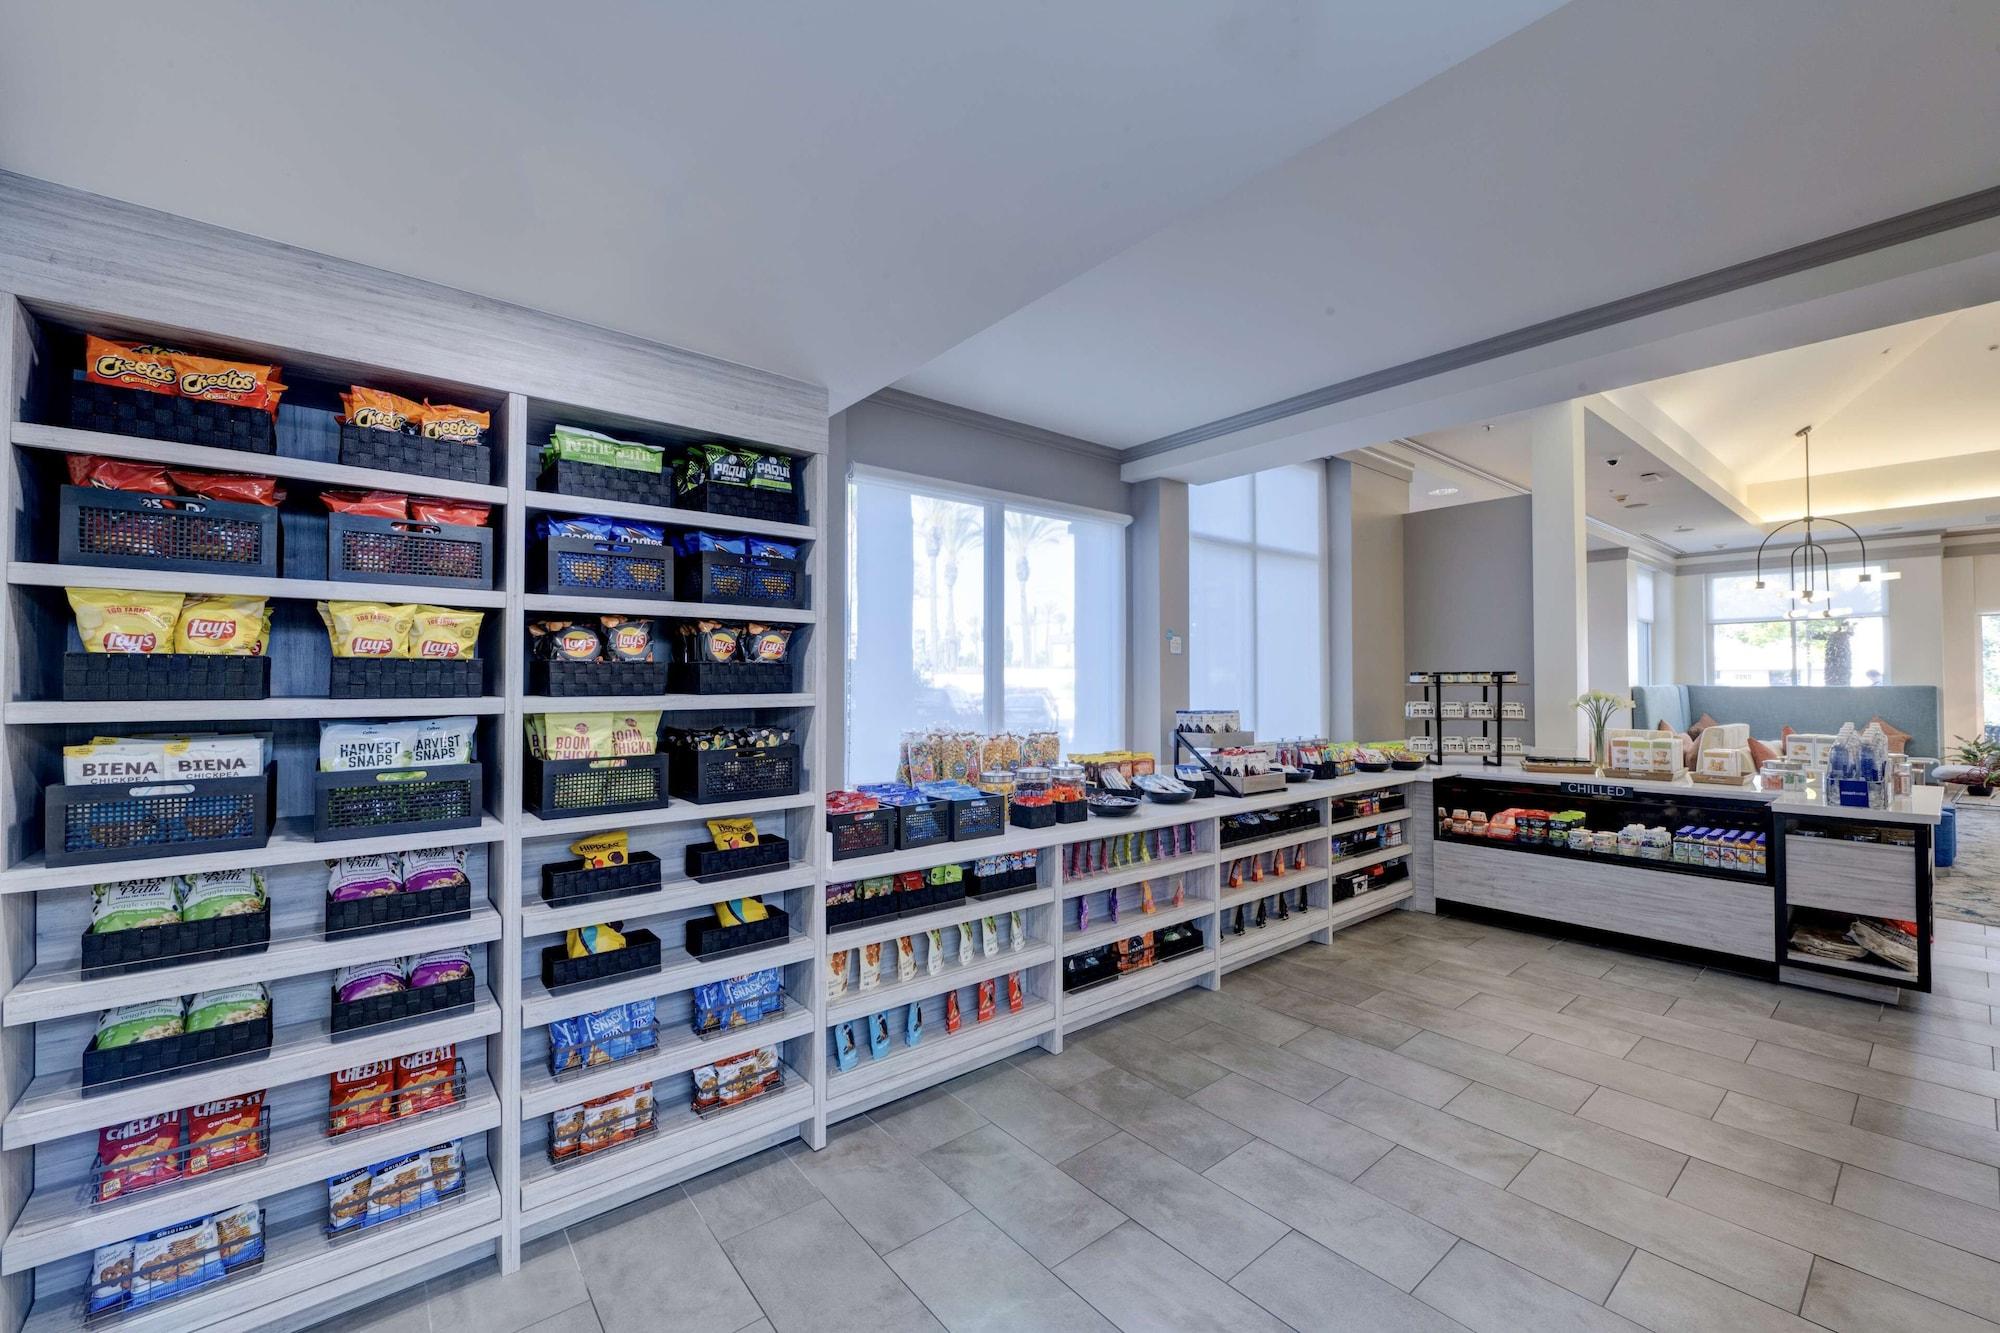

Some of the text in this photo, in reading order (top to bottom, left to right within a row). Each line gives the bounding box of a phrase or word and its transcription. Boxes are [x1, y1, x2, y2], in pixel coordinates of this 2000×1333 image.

[96, 356, 176, 383] Cheetos
[180, 369, 256, 394] Cheetos
[424, 420, 481, 439] Cheetos
[713, 462, 747, 479] PAQUI
[756, 462, 790, 479] PAQUI
[190, 619, 234, 640] Lay's
[107, 632, 154, 653] Lay's
[354, 637, 392, 654] Lay's
[424, 640, 458, 658] Lay's
[564, 637, 595, 652] Lay's
[619, 634, 645, 649] Lay's
[712, 639, 735, 653] Lay's
[760, 641, 784, 654] Lay's
[340, 742, 401, 758] HARVEST
[413, 735, 461, 752] ARVEST
[556, 736, 591, 750] BOOM
[613, 741, 652, 755] CHICKA
[348, 754, 392, 768] SNAPS
[416, 748, 456, 762] SNAPS
[555, 750, 600, 760] CHICKA
[82, 762, 158, 777] BIENA
[178, 758, 247, 772] BIENA
[90, 776, 151, 785] CHICKPEA
[186, 772, 240, 780] CHICKPEA
[1568, 783, 1626, 797] CHILLED
[156, 1224, 194, 1239] ORIGINAL
